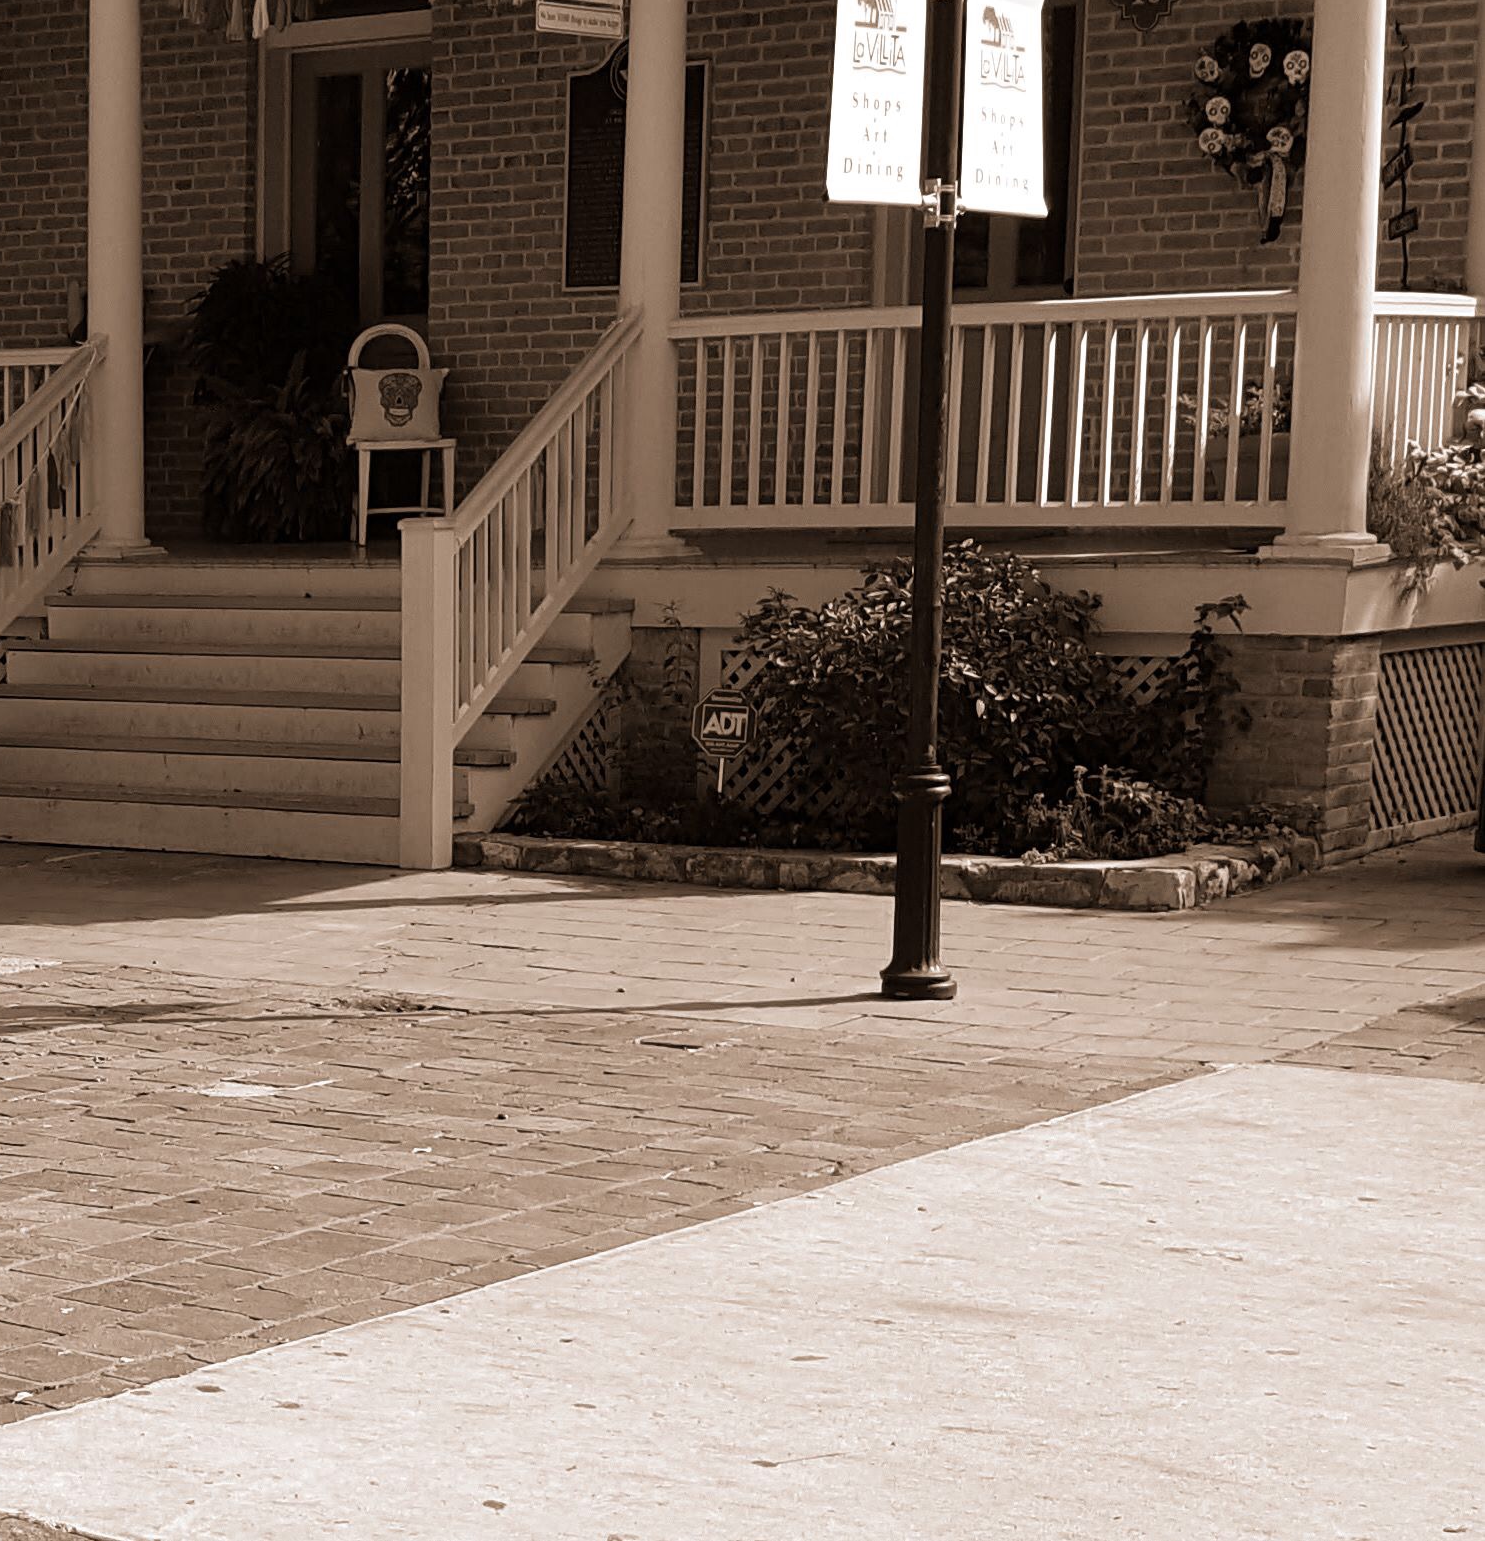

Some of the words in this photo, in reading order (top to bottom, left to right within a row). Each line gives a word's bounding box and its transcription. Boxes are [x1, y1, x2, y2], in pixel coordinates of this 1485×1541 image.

[852, 92, 902, 117] Shops
[981, 106, 1025, 131] Shops
[864, 126, 888, 143] Art
[991, 140, 1014, 157] Art
[843, 157, 904, 182] Dining
[975, 168, 1029, 196] Dining
[702, 711, 747, 737] ADT
